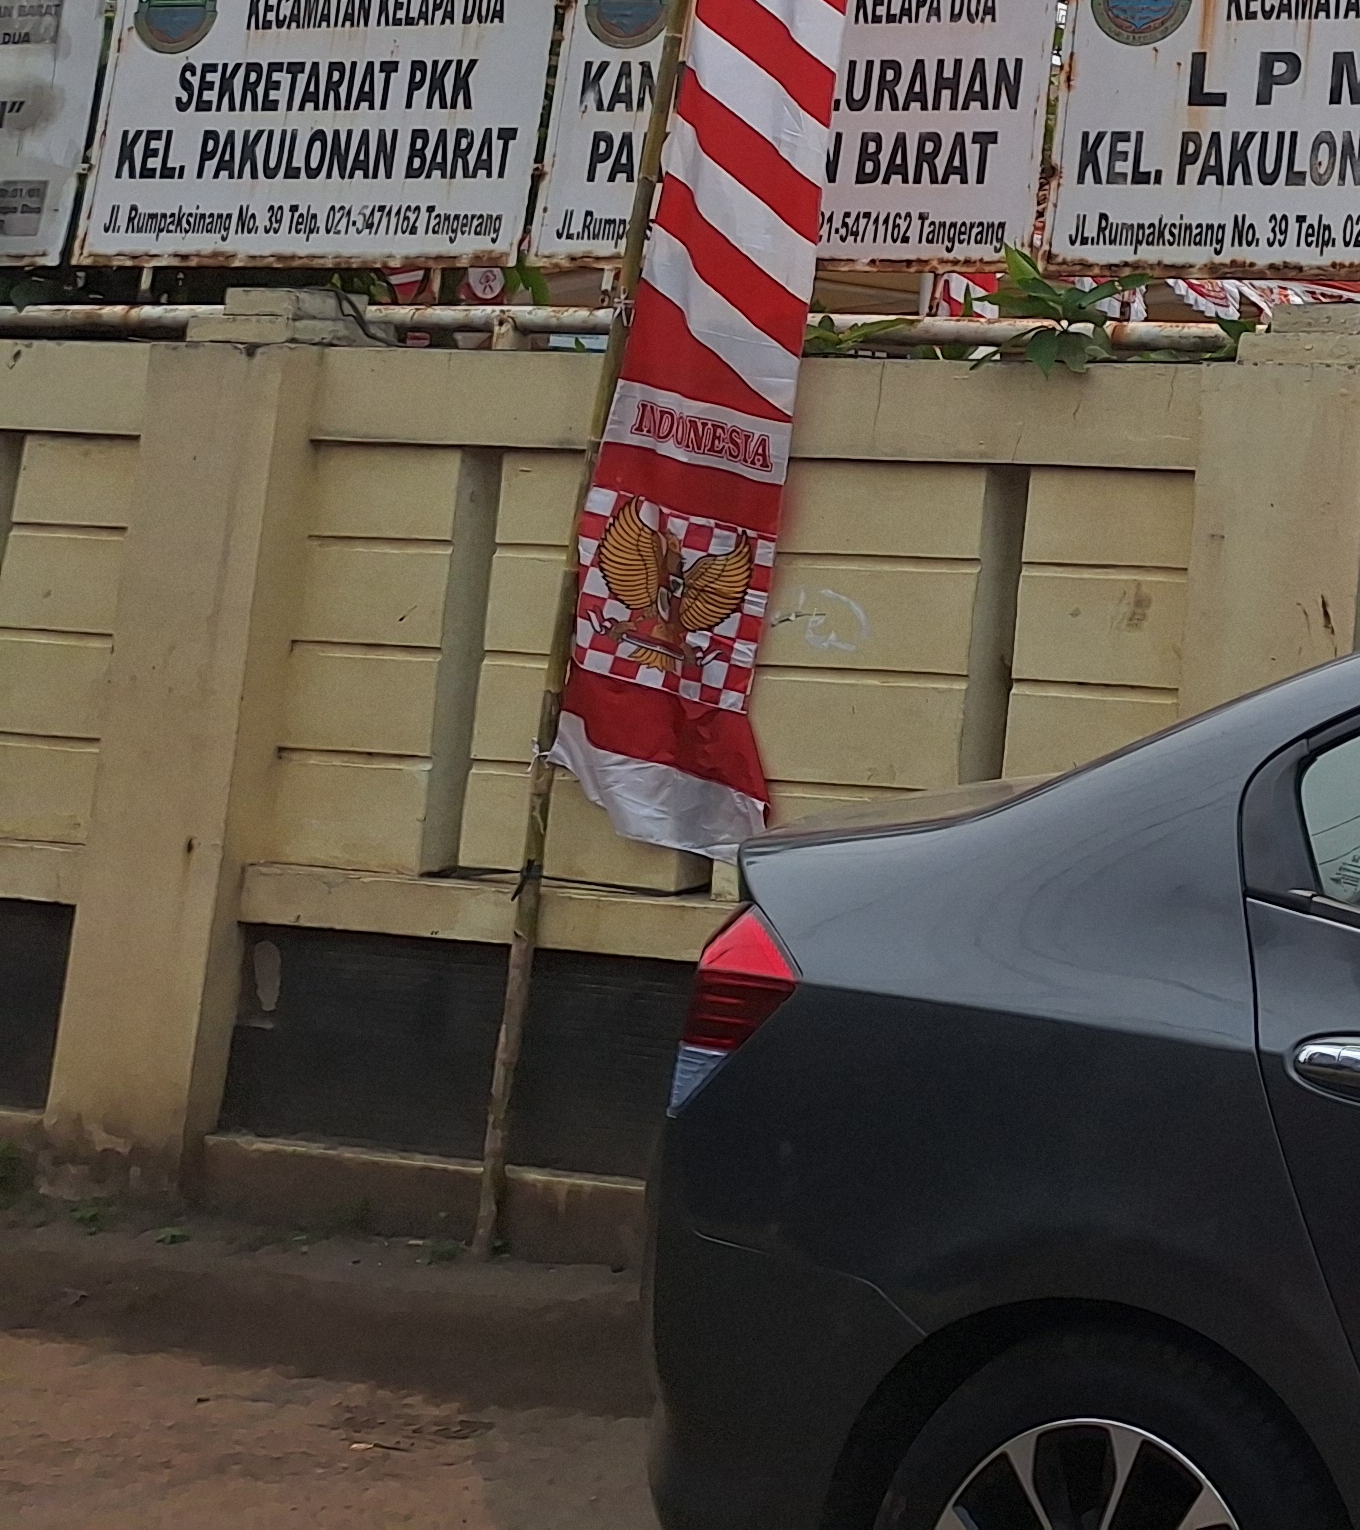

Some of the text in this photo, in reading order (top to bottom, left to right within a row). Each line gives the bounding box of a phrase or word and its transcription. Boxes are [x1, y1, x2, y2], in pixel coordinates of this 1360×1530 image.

[175, 58, 478, 113] SEKRETARIAT PKK
[833, 58, 1023, 112] URAHAN
[115, 127, 518, 180] KEL. PAKULONAN BARAT
[855, 131, 998, 185] BARAT
[1077, 131, 1163, 186] KEL.
[125, 204, 234, 242] Rumpaksinang
[235, 204, 259, 235] No.
[264, 204, 284, 234] 39
[287, 204, 320, 243] Telp.
[325, 204, 421, 236] 021-5471162
[424, 204, 503, 244] Tangerang
[917, 212, 1007, 254] Tangerang
[1231, 214, 1260, 249] No.
[1266, 214, 1289, 248] 39
[1294, 215, 1337, 257] Telp.
